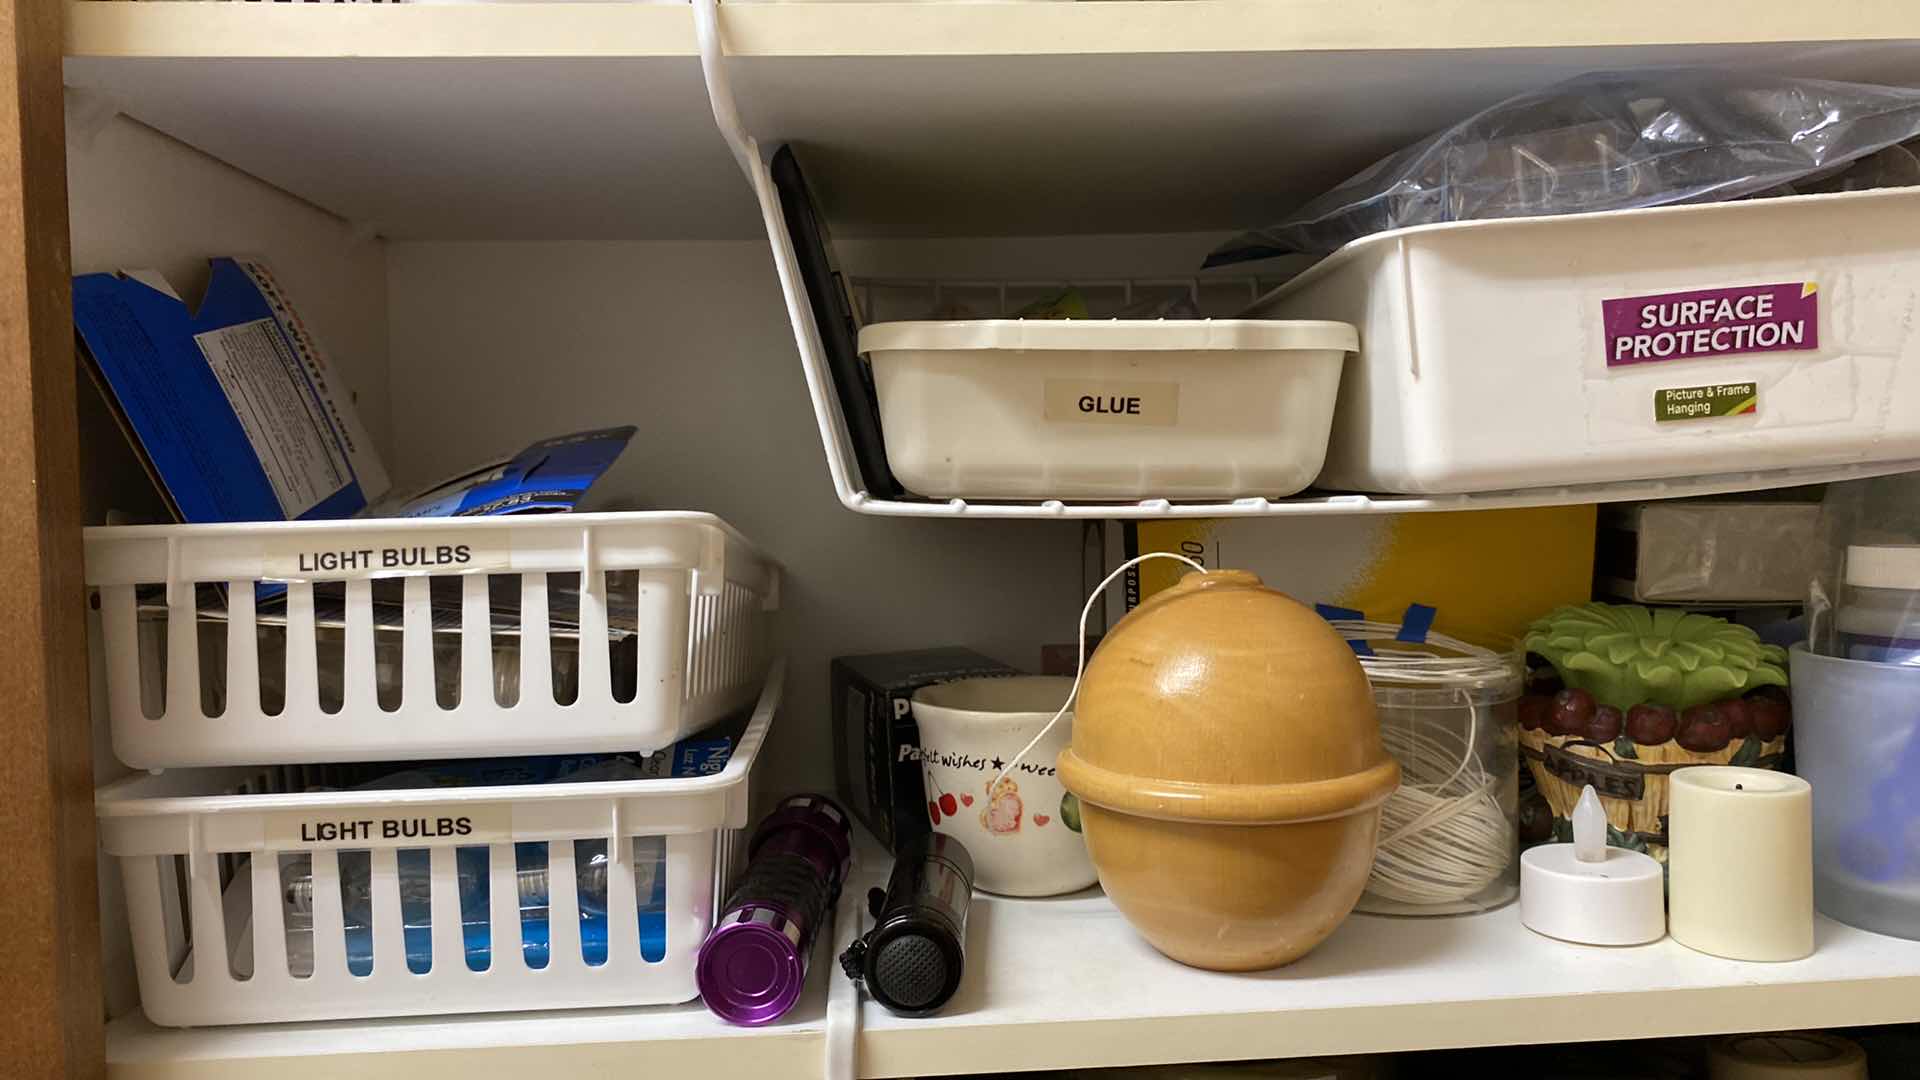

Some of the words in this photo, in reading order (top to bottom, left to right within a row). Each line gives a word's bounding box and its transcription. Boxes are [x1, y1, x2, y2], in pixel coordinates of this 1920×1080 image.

[1640, 293, 1774, 329] SURFACE
[1615, 320, 1805, 360] PROTECTION
[1666, 386, 1704, 401] Picture
[1706, 386, 1714, 398] &
[1717, 383, 1751, 398] Frame
[1079, 395, 1141, 414] GLUE
[1667, 400, 1711, 416] Hanging
[299, 550, 373, 572] LIGHT
[382, 544, 471, 568] BULBS
[940, 752, 986, 770] wishes
[301, 820, 373, 841] LIGHT
[382, 817, 472, 839] BULBS
